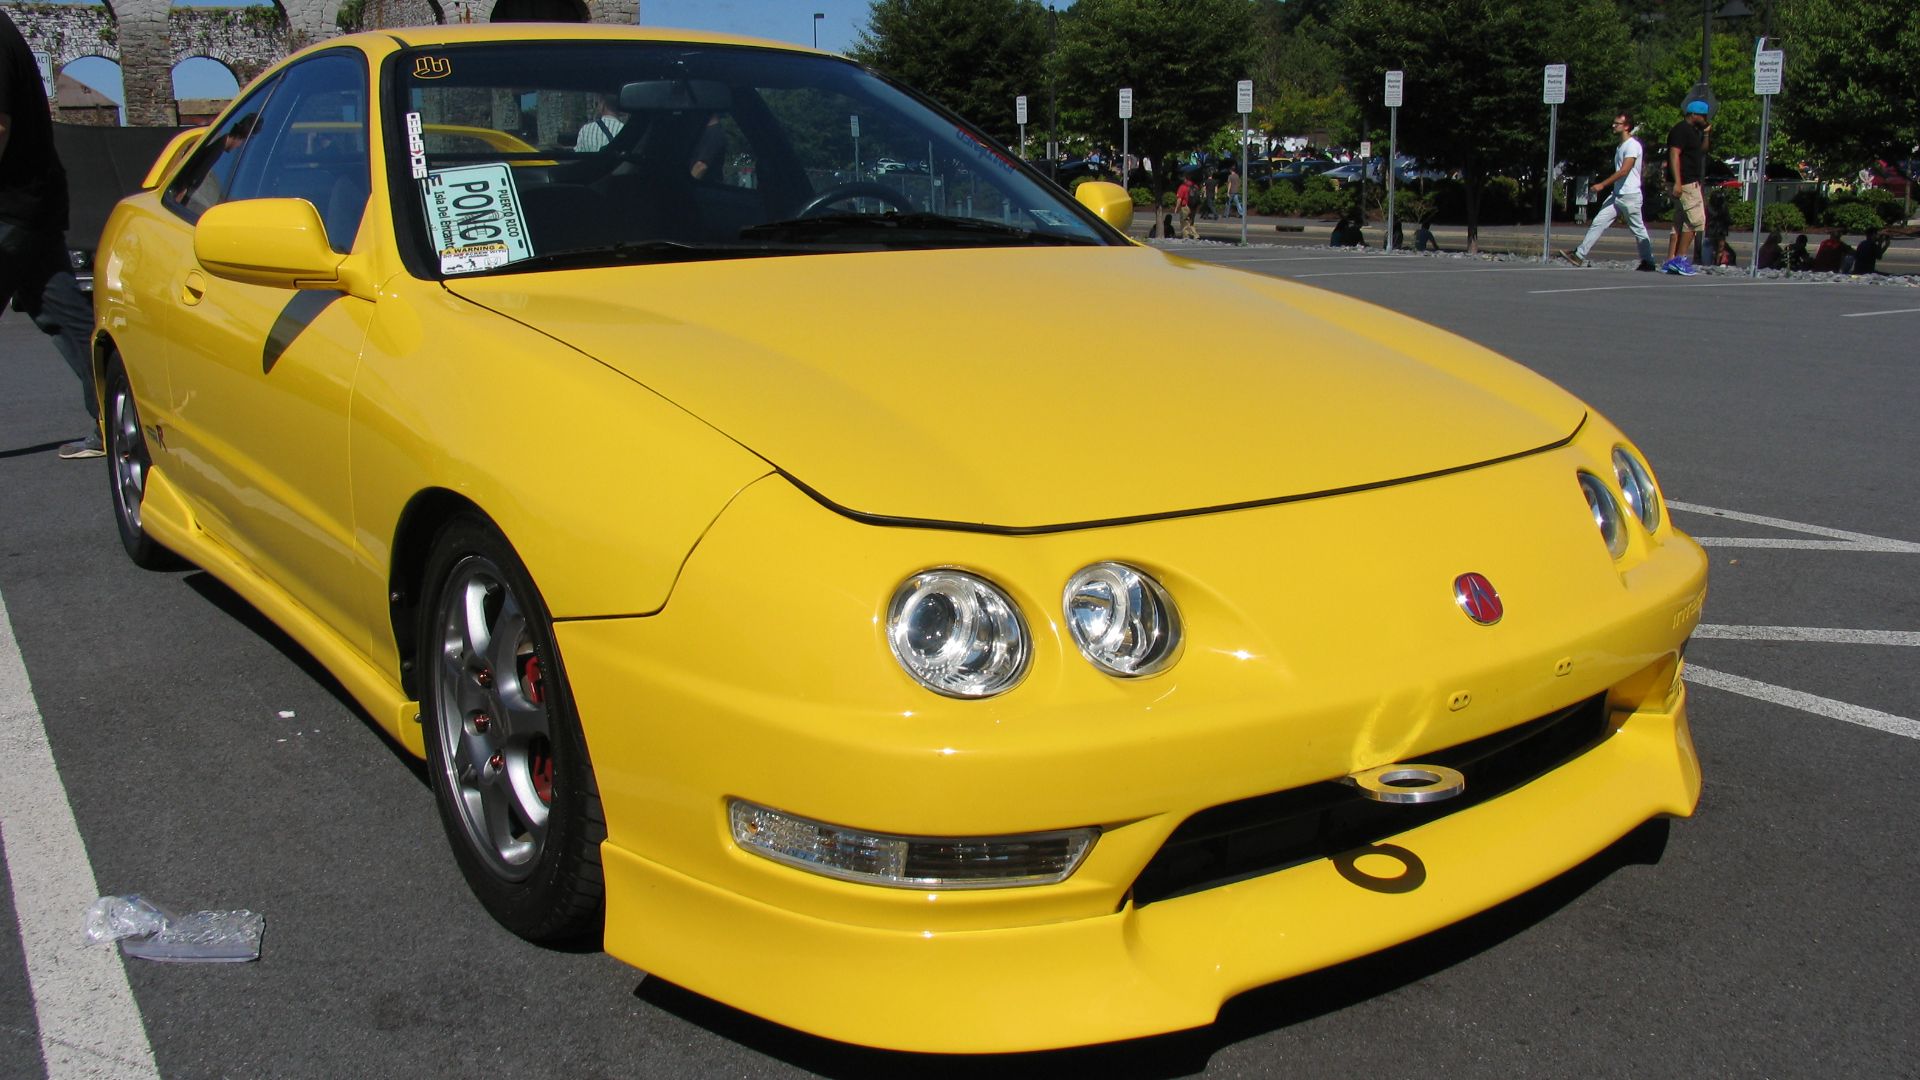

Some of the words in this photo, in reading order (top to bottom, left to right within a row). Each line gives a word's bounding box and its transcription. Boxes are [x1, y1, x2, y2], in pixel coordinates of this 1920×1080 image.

[434, 191, 446, 205] Isla
[498, 189, 515, 217] PUERTO
[437, 206, 450, 219] Del
[505, 219, 519, 238] RICO
[454, 245, 496, 254] WARNING
